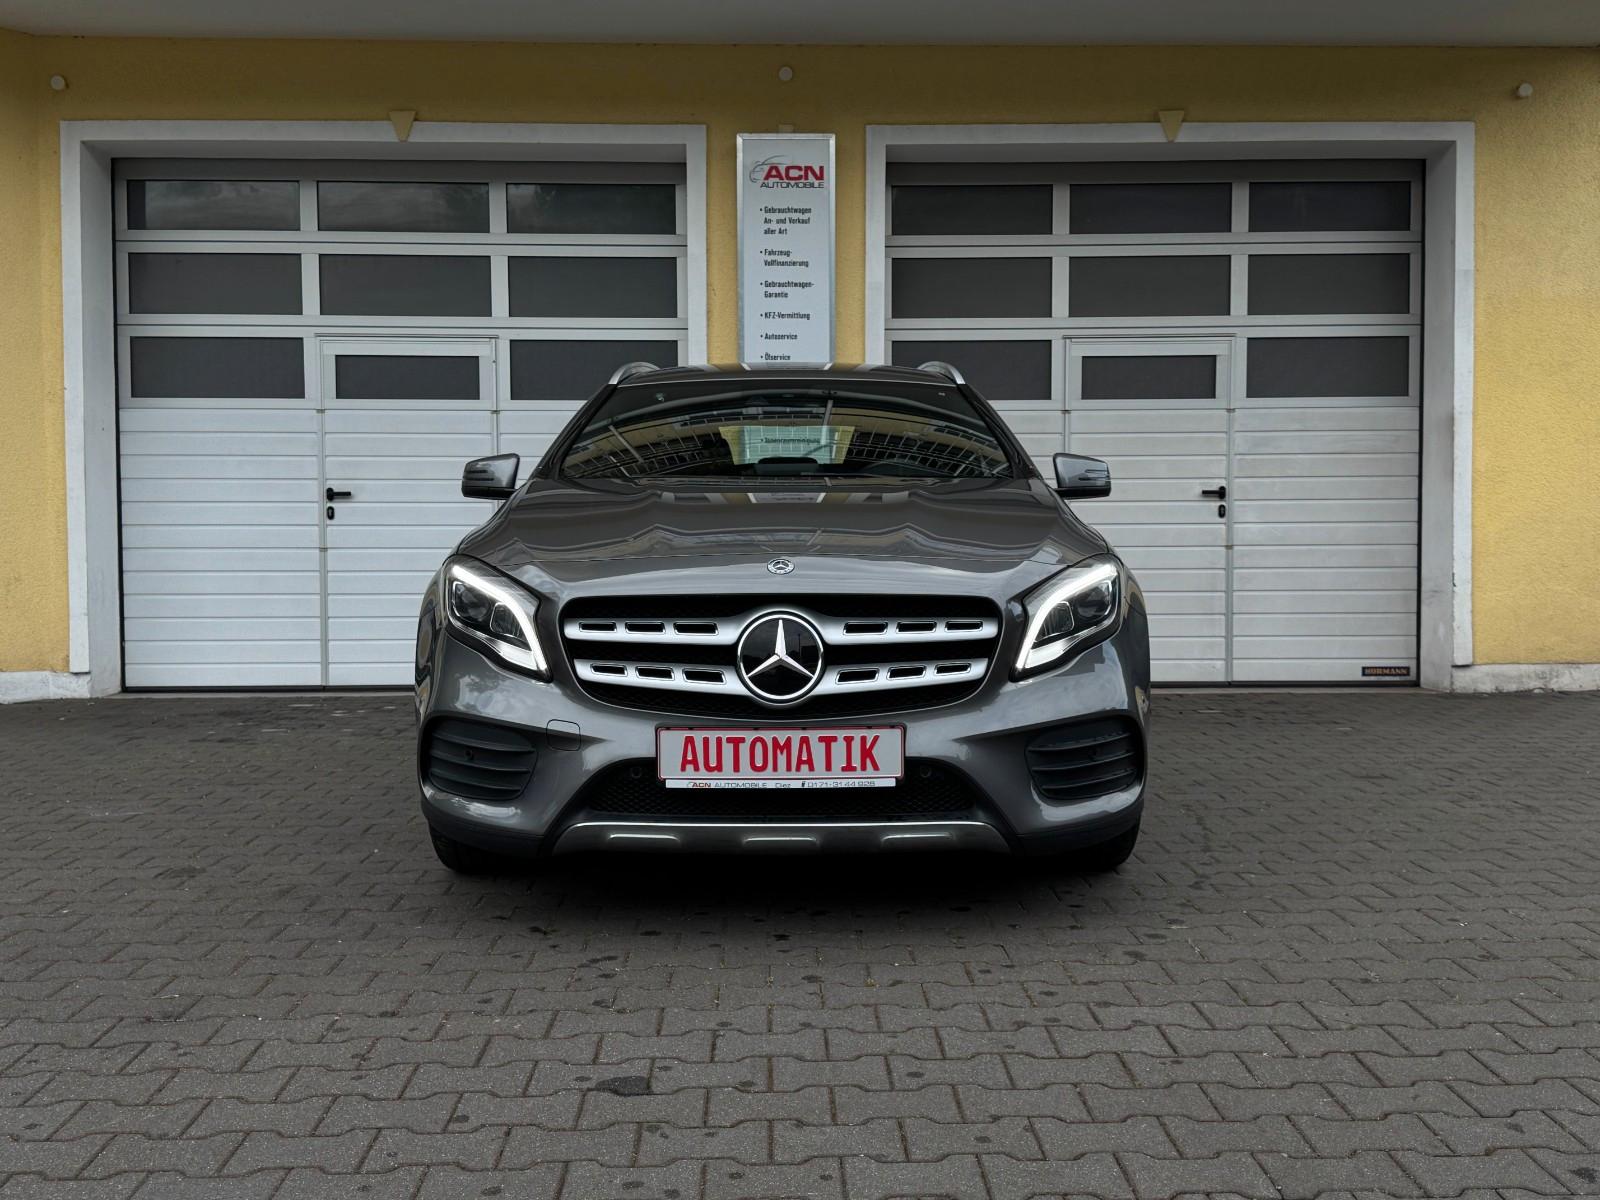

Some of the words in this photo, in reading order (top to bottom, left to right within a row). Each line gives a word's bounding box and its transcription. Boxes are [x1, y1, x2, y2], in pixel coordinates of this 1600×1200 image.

[764, 165, 824, 181] ACN
[760, 181, 824, 189] AUTOMOBILE
[764, 206, 812, 215] Gebrauchtwagen
[764, 249, 792, 257] Fahrzeug-
[764, 259, 809, 268] Vollfinanzierung
[764, 280, 815, 288] Gebrauchtwagen-
[764, 312, 811, 320] KFZ-Vermittlung
[764, 352, 791, 361] Ölservice
[680, 734, 881, 773] AUTOMATIK
